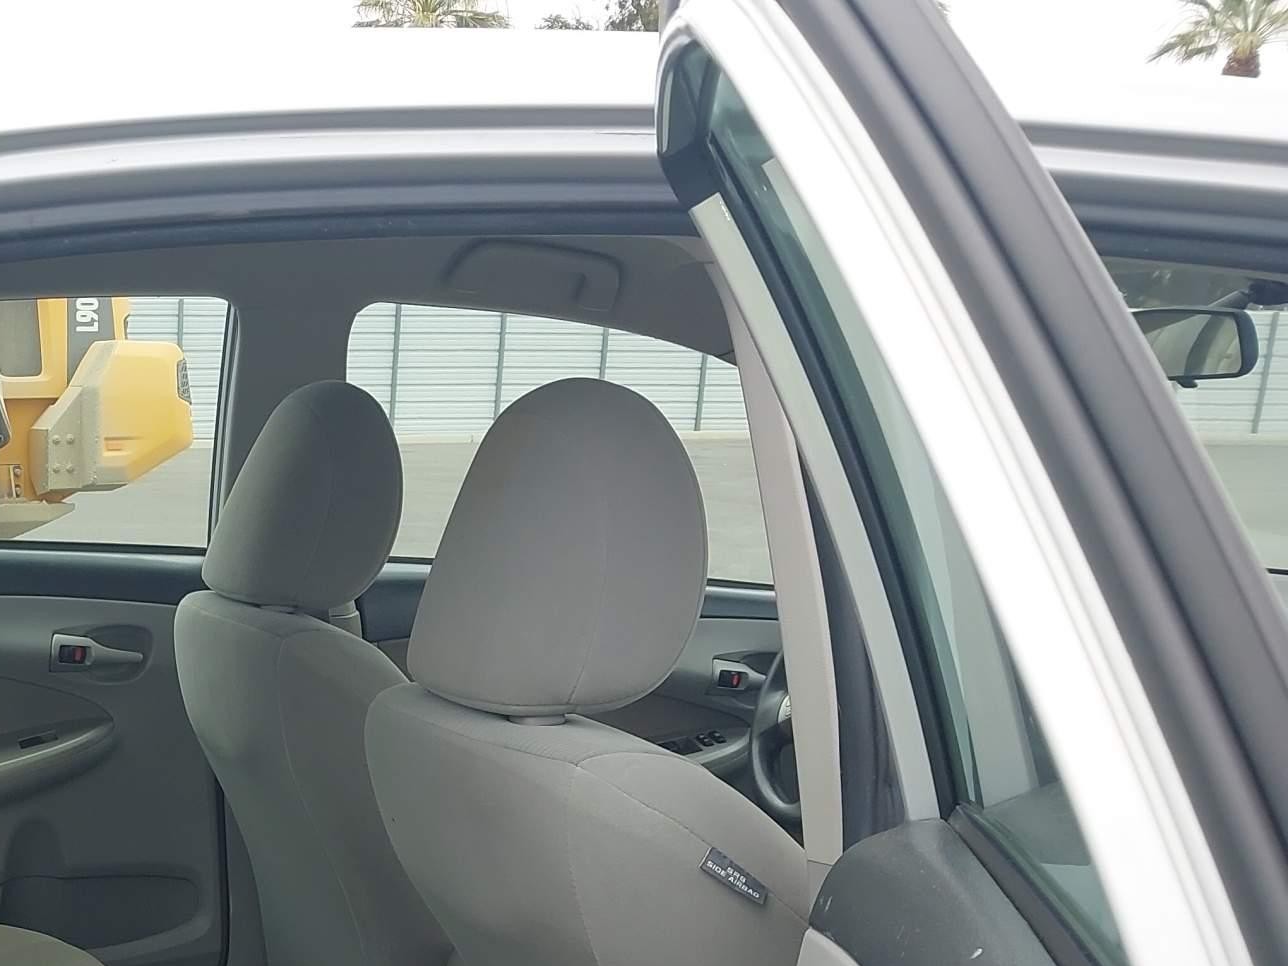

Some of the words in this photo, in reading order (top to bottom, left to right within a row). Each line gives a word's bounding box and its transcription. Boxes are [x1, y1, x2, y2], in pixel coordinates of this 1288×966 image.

[75, 297, 99, 332] L90
[706, 860, 727, 878] SIDE
[727, 876, 761, 899] AIRBAG
[726, 866, 747, 884] SRS
